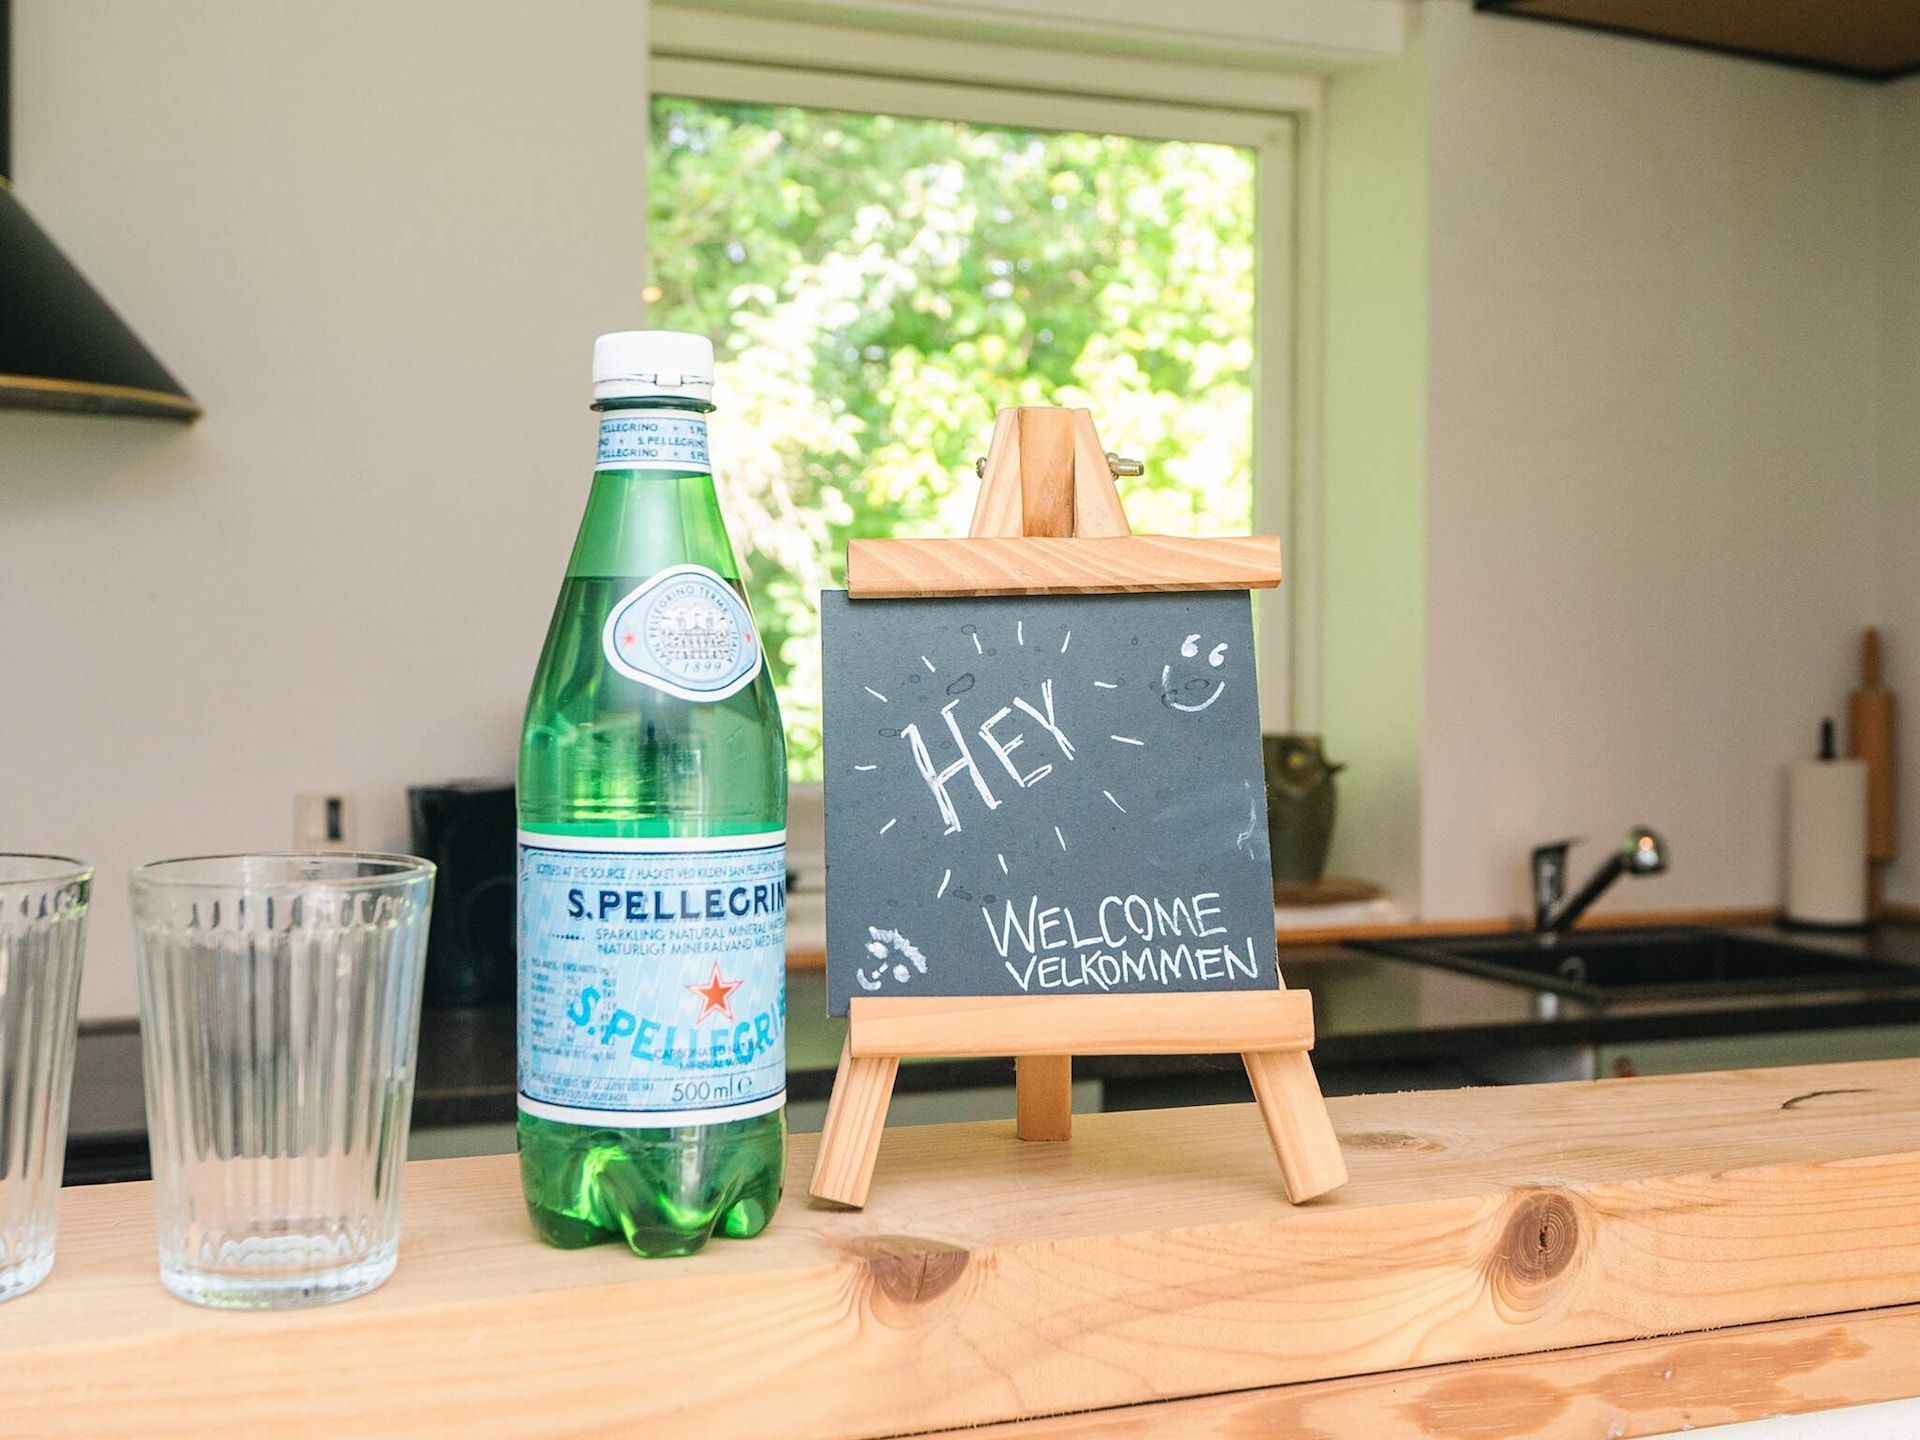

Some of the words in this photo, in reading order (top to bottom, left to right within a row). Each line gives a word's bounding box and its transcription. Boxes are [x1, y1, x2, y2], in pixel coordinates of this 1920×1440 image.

[901, 678, 1075, 835] HEY
[596, 927, 665, 941] SPARKLING
[670, 926, 724, 940] NATURAL
[982, 892, 1227, 957] WELCOME
[1005, 937, 1259, 991] VELKOMMEN
